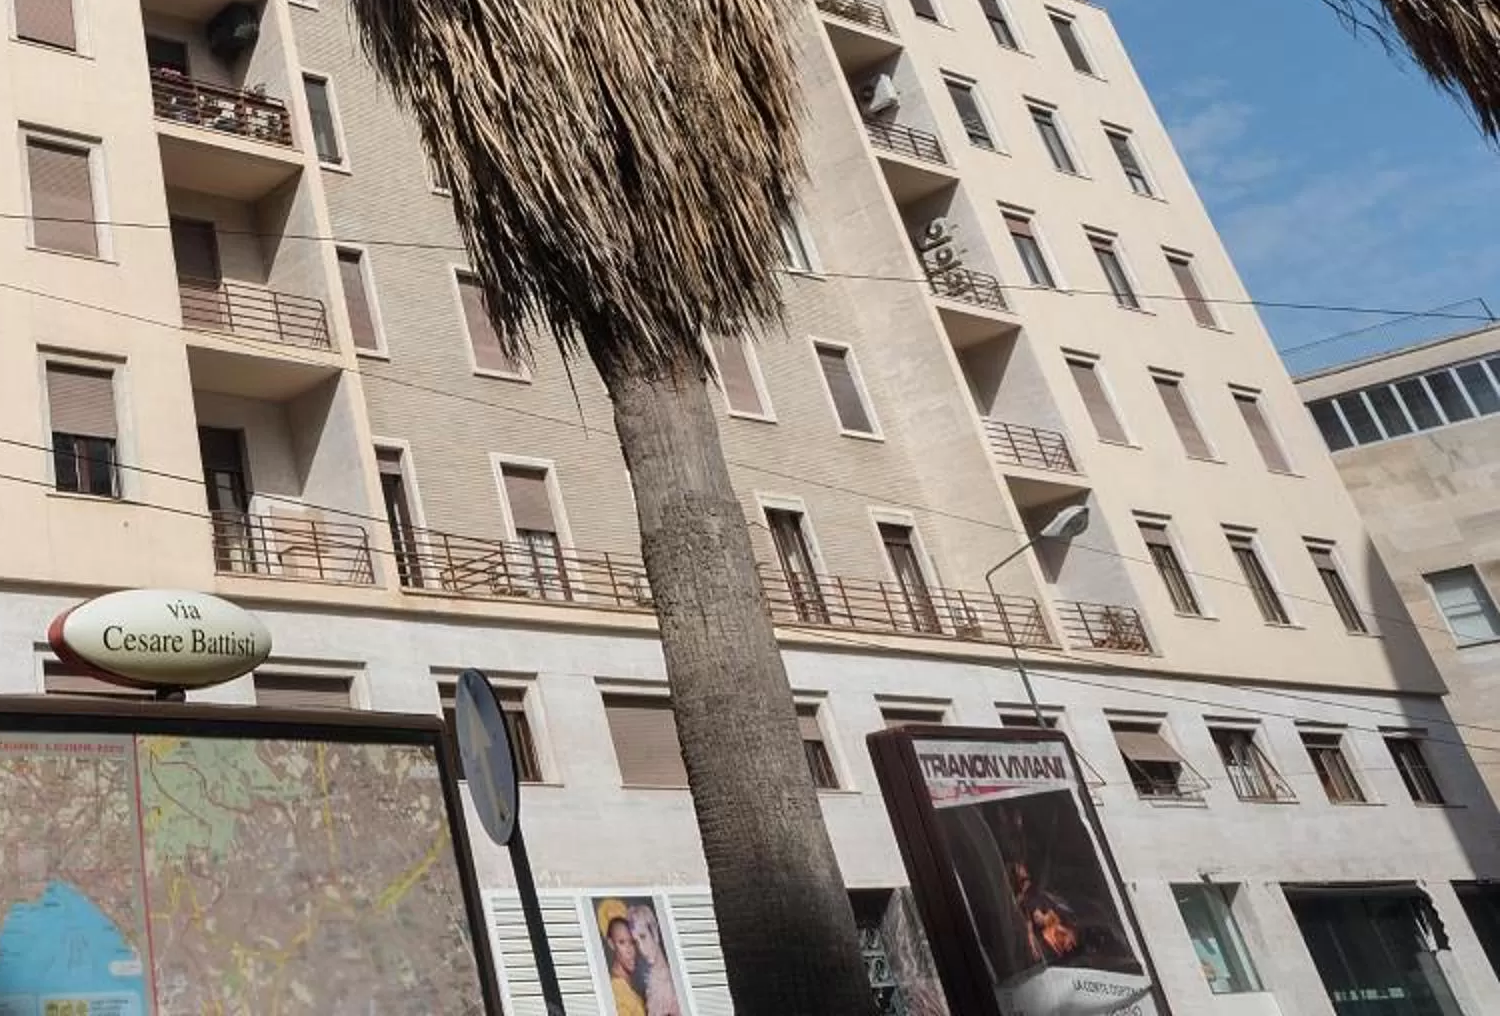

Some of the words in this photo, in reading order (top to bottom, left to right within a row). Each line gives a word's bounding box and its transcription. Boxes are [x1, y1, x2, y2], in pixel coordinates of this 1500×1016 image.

[167, 600, 202, 621] via
[103, 625, 186, 654] Cesare
[191, 629, 256, 658] Battisti
[919, 753, 1000, 779] TRIANON
[999, 755, 1066, 780] VIVIANI
